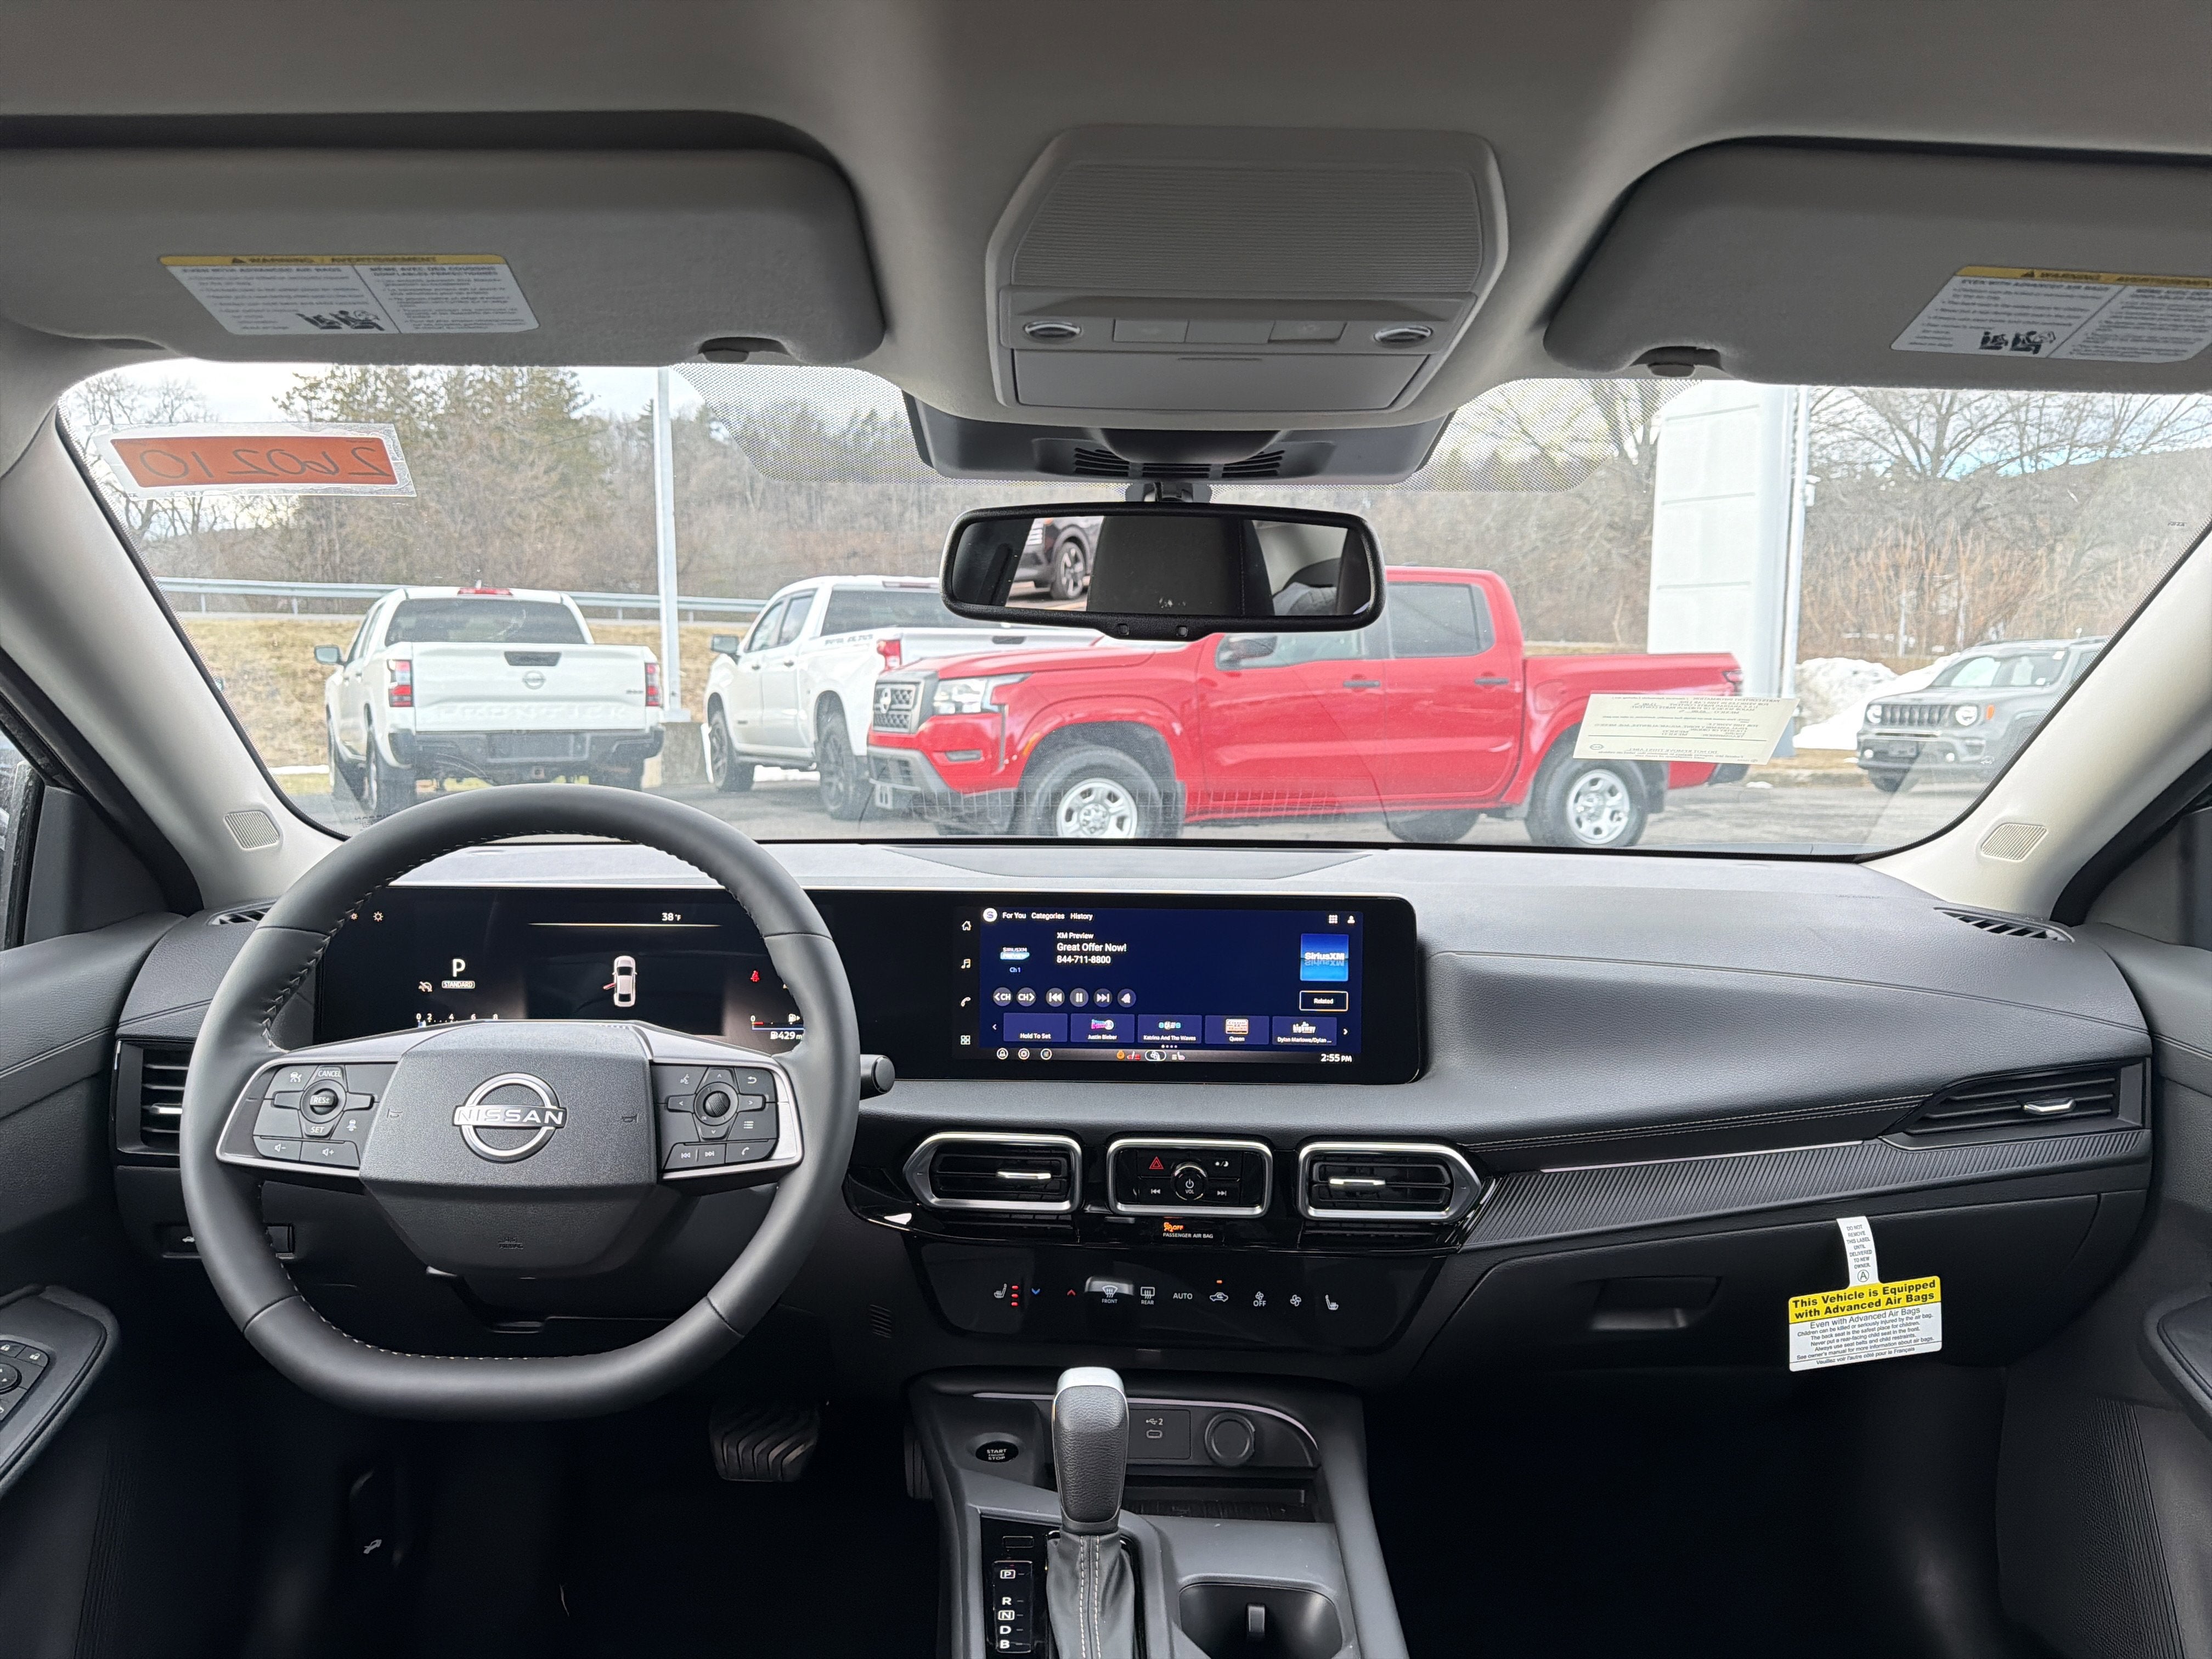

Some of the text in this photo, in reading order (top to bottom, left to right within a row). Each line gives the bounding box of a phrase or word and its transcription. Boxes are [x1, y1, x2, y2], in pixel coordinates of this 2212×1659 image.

[1070, 913, 1093, 921] History
[1057, 943, 1127, 952] Great Offer Now!
[1057, 955, 1111, 964] 844-711-8800
[1305, 952, 1345, 961] SiriusXM
[452, 958, 466, 977] P
[778, 1031, 795, 1040] 429
[1321, 1053, 1340, 1062] 2:55
[457, 1108, 563, 1124] NISSAN
[1792, 1279, 1936, 1308] This Vehicle is Equipped
[1795, 1291, 1935, 1319] with Advanced Air Bags
[1849, 1311, 1886, 1323] Advanced
[1858, 1320, 1880, 1328] seriously
[1000, 1626, 1011, 1634] D
[1000, 1640, 1010, 1649] B
